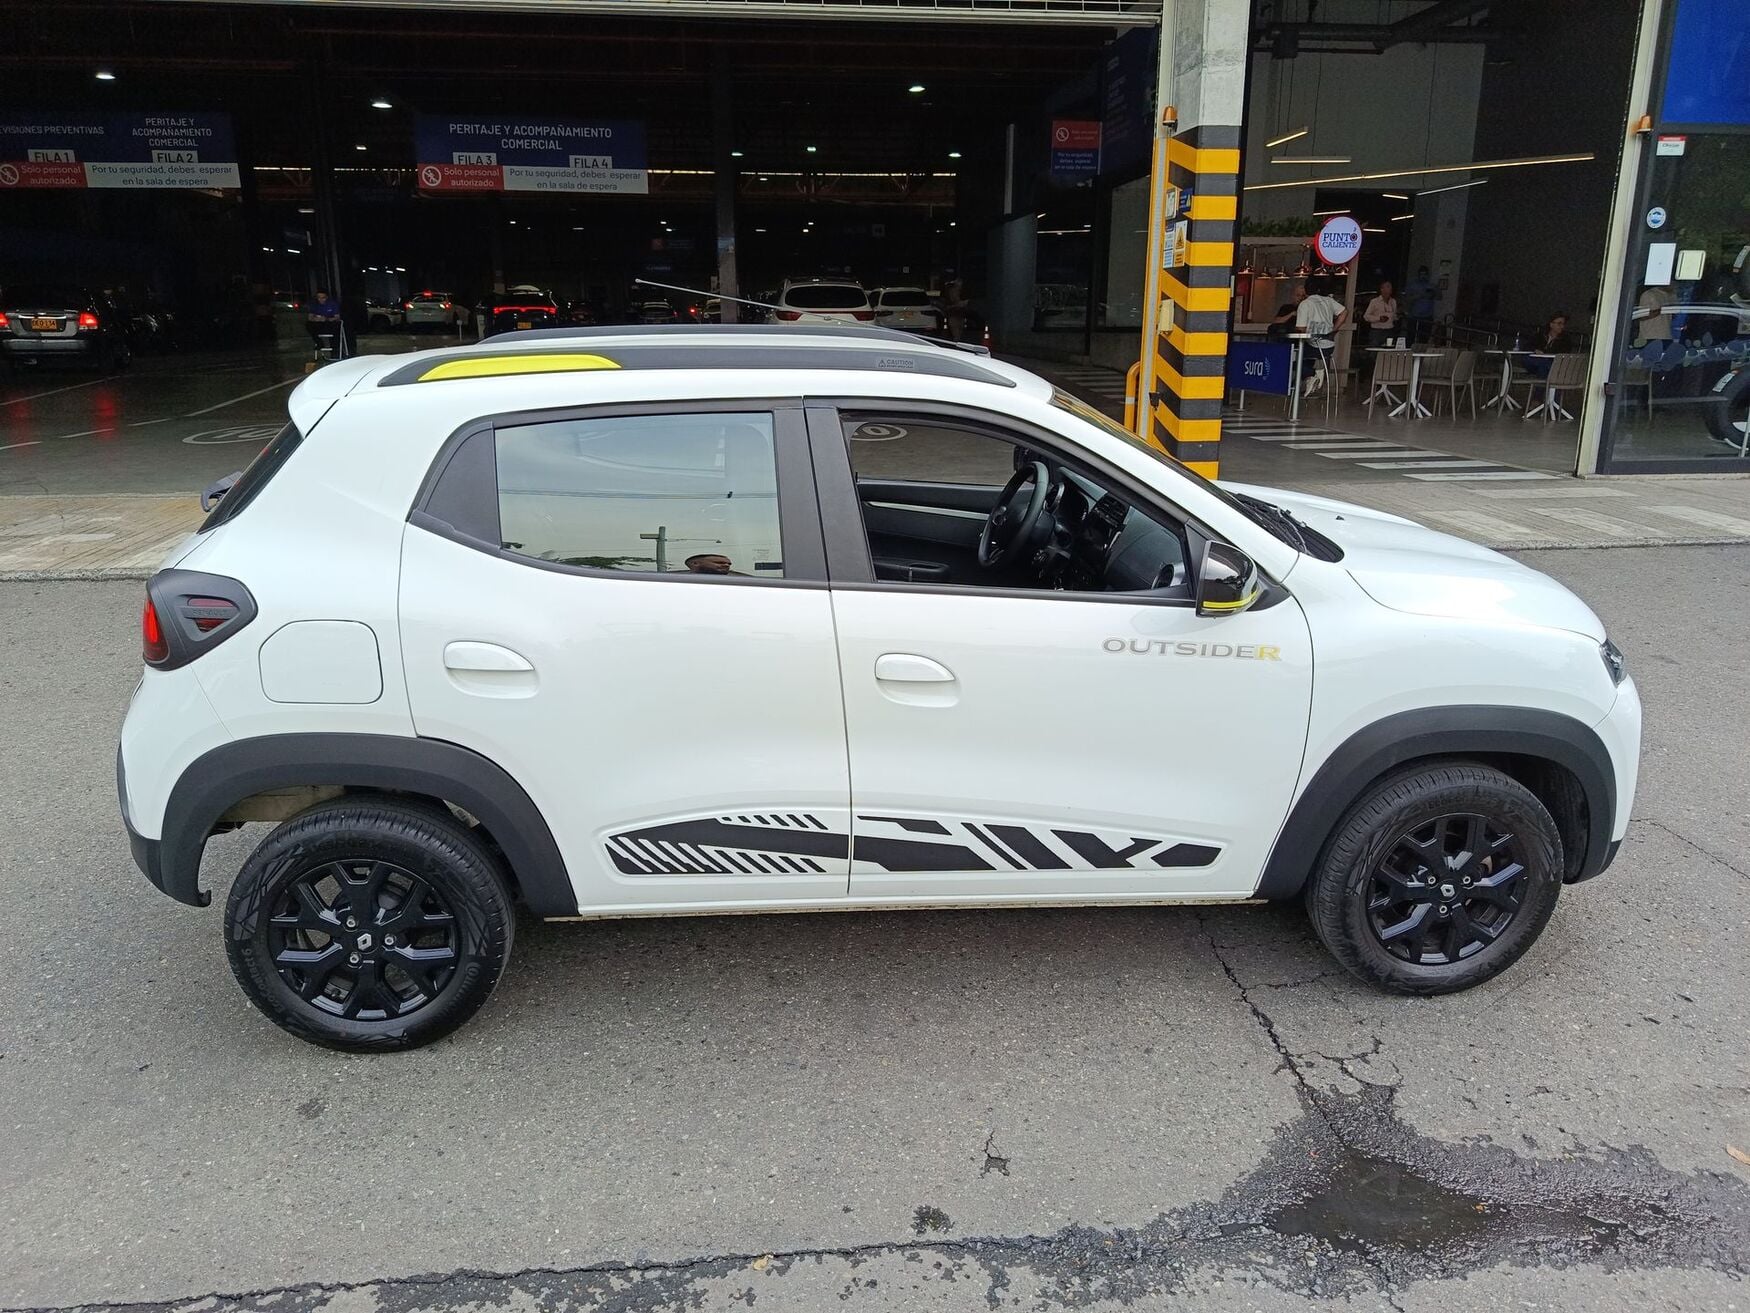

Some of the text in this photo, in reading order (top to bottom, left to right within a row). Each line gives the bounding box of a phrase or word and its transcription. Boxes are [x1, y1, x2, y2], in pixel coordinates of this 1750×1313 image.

[145, 117, 195, 126] PERITAJE Y
[44, 125, 105, 135] PREVENTIVAS
[449, 123, 612, 138] PERITAJE Y ACOMPAÑAMIENTO
[148, 138, 199, 147] COMERCIAL
[501, 138, 563, 150] COMERCIAL
[34, 152, 70, 162] FILA 1
[157, 153, 193, 163] FILA 2
[458, 155, 492, 165] FILA 3
[574, 158, 608, 168] FILA 4
[21, 165, 82, 176] Solo personal
[91, 165, 107, 174] Por
[108, 166, 118, 174] tu
[167, 165, 195, 174] debes
[199, 167, 232, 176] esperar
[443, 167, 500, 178] Solo personal
[509, 168, 523, 176] Por
[524, 169, 534, 177] tu
[580, 171, 607, 179] debes
[609, 173, 641, 182] esperar
[30, 176, 77, 185] autorizado
[136, 177, 144, 185] la
[145, 177, 163, 185] sala
[165, 177, 177, 185] de
[178, 178, 208, 187] espera
[450, 178, 494, 187] autorizado
[549, 181, 557, 189] la
[558, 181, 575, 190] sala
[576, 182, 588, 190] de
[589, 183, 618, 192] espera
[1323, 232, 1358, 242] PUNTO
[1321, 241, 1358, 249] CALIENTE
[886, 358, 914, 366] CAUTION
[1244, 360, 1264, 376] sura
[1102, 638, 1282, 661] OUTSIDER
